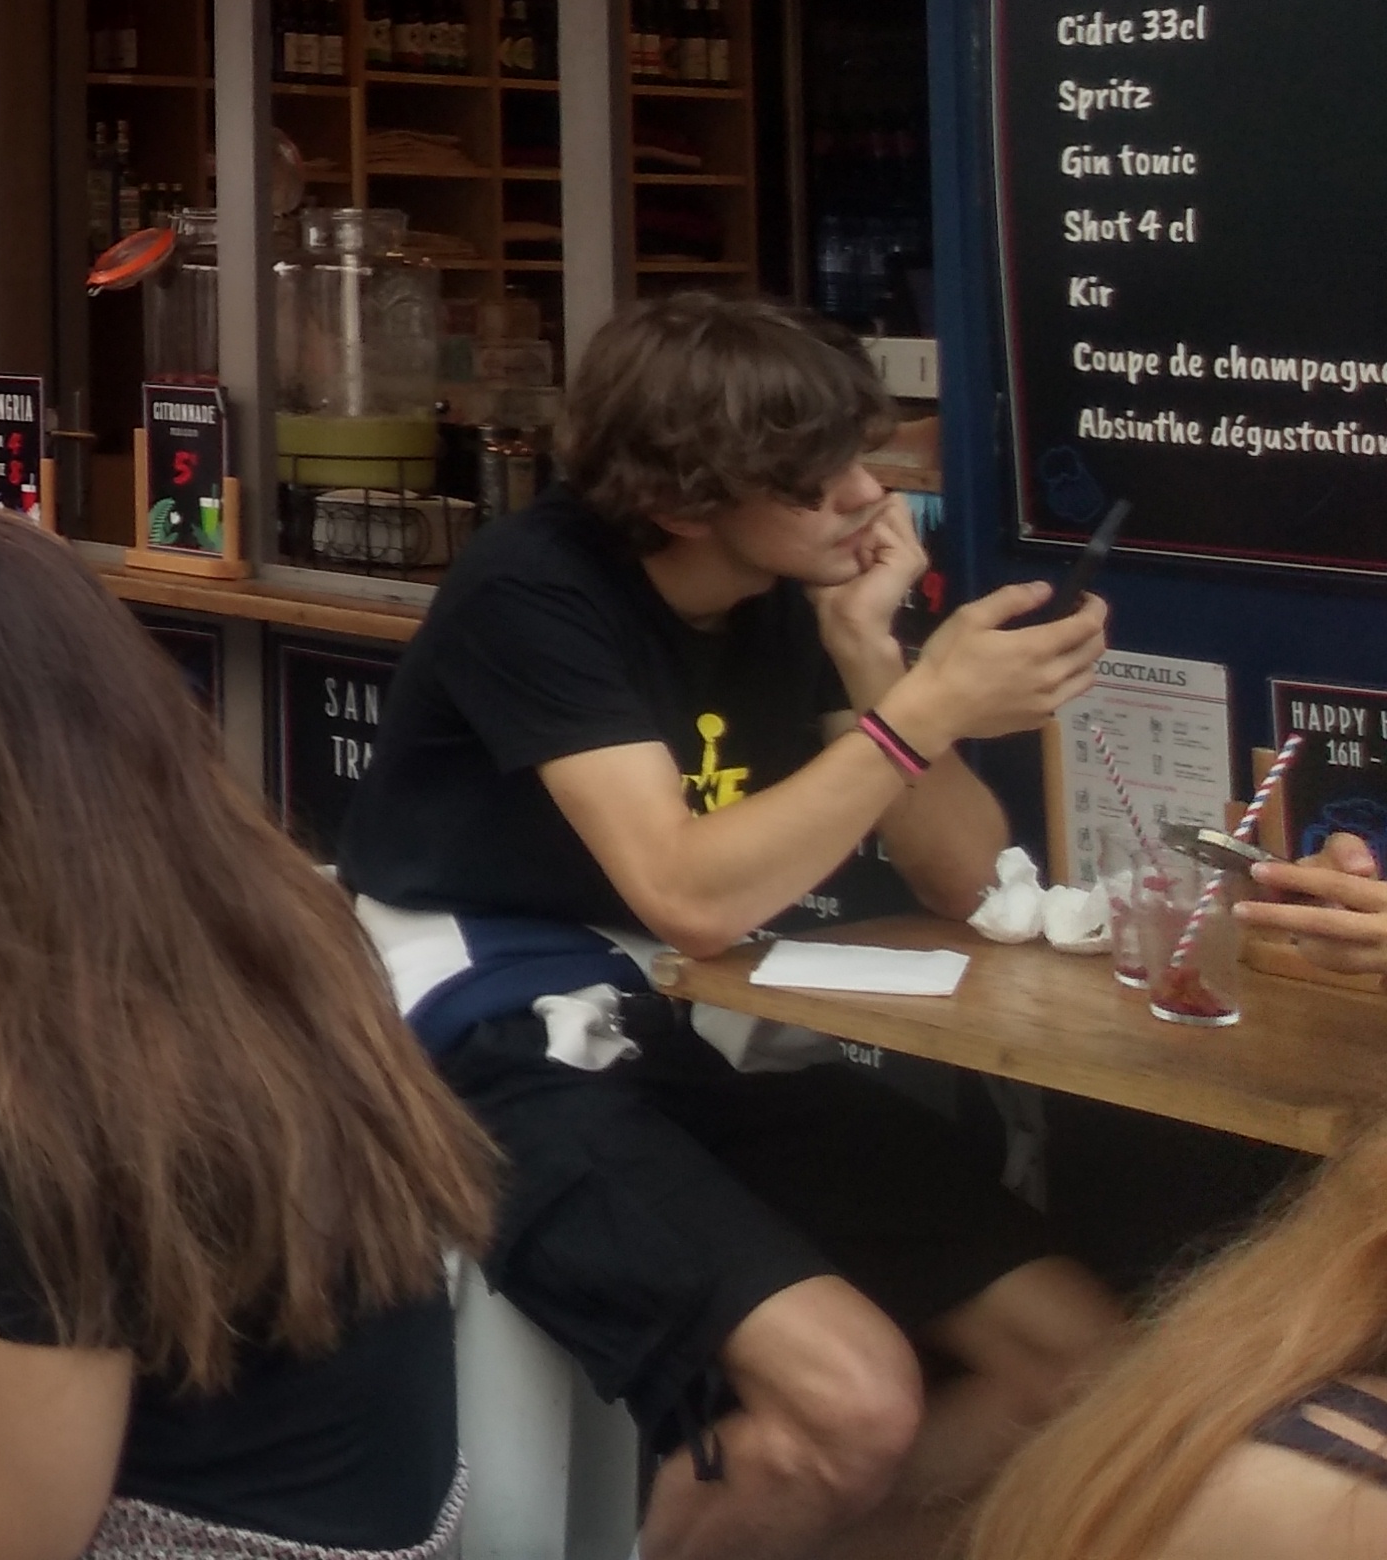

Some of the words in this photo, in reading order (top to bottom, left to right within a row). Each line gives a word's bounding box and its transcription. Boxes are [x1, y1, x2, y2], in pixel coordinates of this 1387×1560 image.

[1056, 10, 1135, 47] Cidre
[1142, 5, 1206, 42] 33cl
[1058, 77, 1153, 121] Spritz
[1061, 145, 1111, 179] Gin
[1117, 144, 1197, 176] tonic
[1064, 209, 1132, 243] Shot
[1137, 209, 1163, 241] 4
[1168, 207, 1196, 243] cl
[1067, 275, 1115, 308] Kir
[1073, 341, 1161, 385] Coupe
[1169, 341, 1204, 379] de
[153, 401, 216, 424] CITRONNADE
[1078, 407, 1203, 447] Absinthe
[1291, 701, 1366, 736] HAPPY
[1327, 739, 1363, 768] 16H
